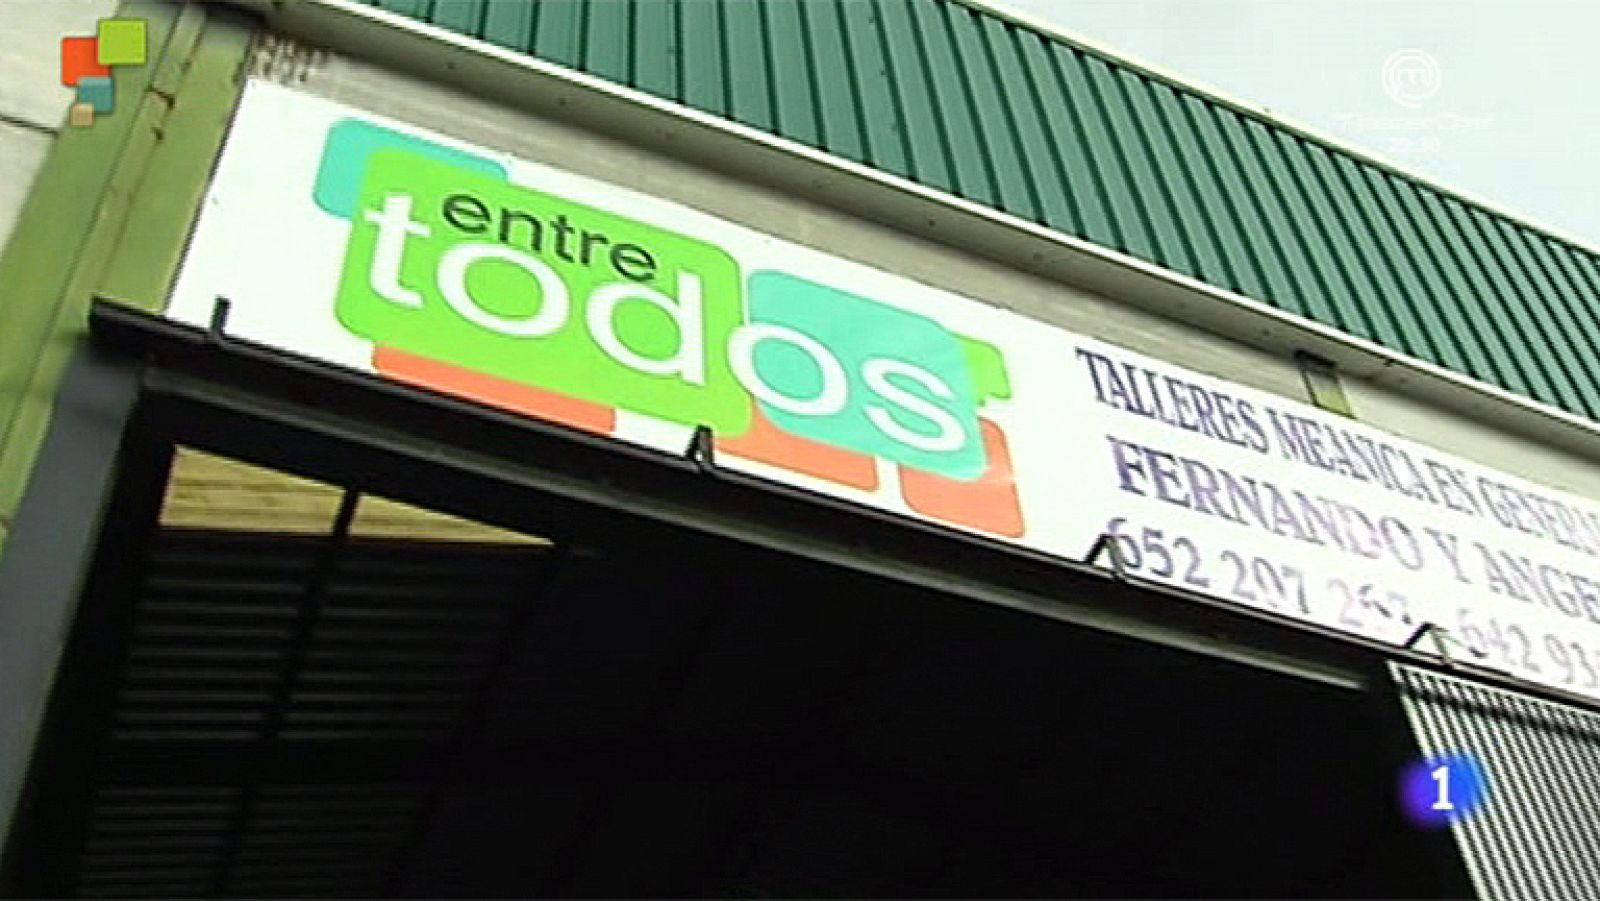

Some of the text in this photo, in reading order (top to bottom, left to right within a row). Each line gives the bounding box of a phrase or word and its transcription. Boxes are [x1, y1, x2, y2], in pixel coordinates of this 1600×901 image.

[441, 193, 657, 283] entre
[362, 194, 967, 452] todos
[1074, 346, 1270, 454] TALLERES
[1105, 433, 1424, 570] FERNANDO
[1422, 526, 1475, 585] Y
[1106, 516, 1210, 589] 652
[1219, 548, 1312, 615] 207
